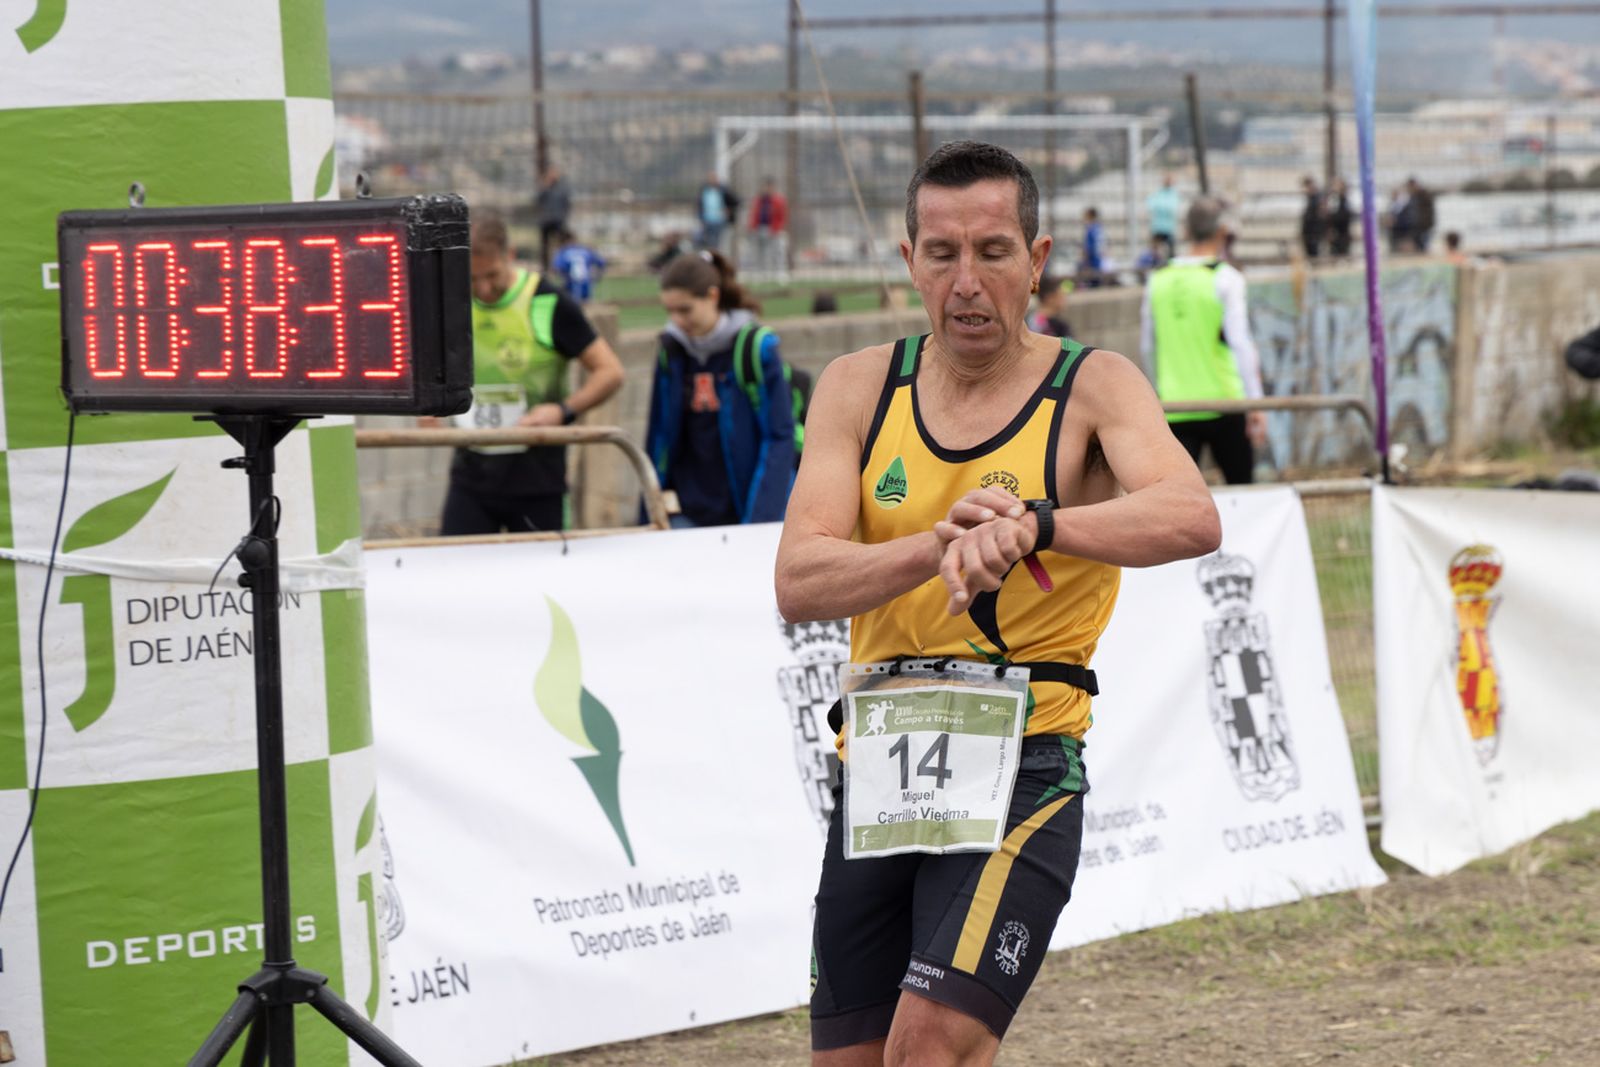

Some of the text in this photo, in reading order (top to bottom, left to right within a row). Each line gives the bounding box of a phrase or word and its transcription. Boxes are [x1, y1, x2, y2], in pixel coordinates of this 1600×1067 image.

[691, 373, 720, 412] A
[876, 473, 907, 492] Jaén
[126, 590, 301, 625] DIPUTACN
[129, 627, 253, 666] DE JAÉN
[894, 715, 923, 725] Campo
[934, 714, 964, 725] través
[888, 733, 953, 790] 14
[877, 806, 970, 824] Carrillo Viedma
[902, 790, 935, 804] Miguel
[533, 869, 741, 925] Patronato Municipal de
[86, 914, 318, 970] DEPORTS
[570, 906, 732, 961] Deportes de Jaén
[408, 956, 470, 1004] JAÉN
